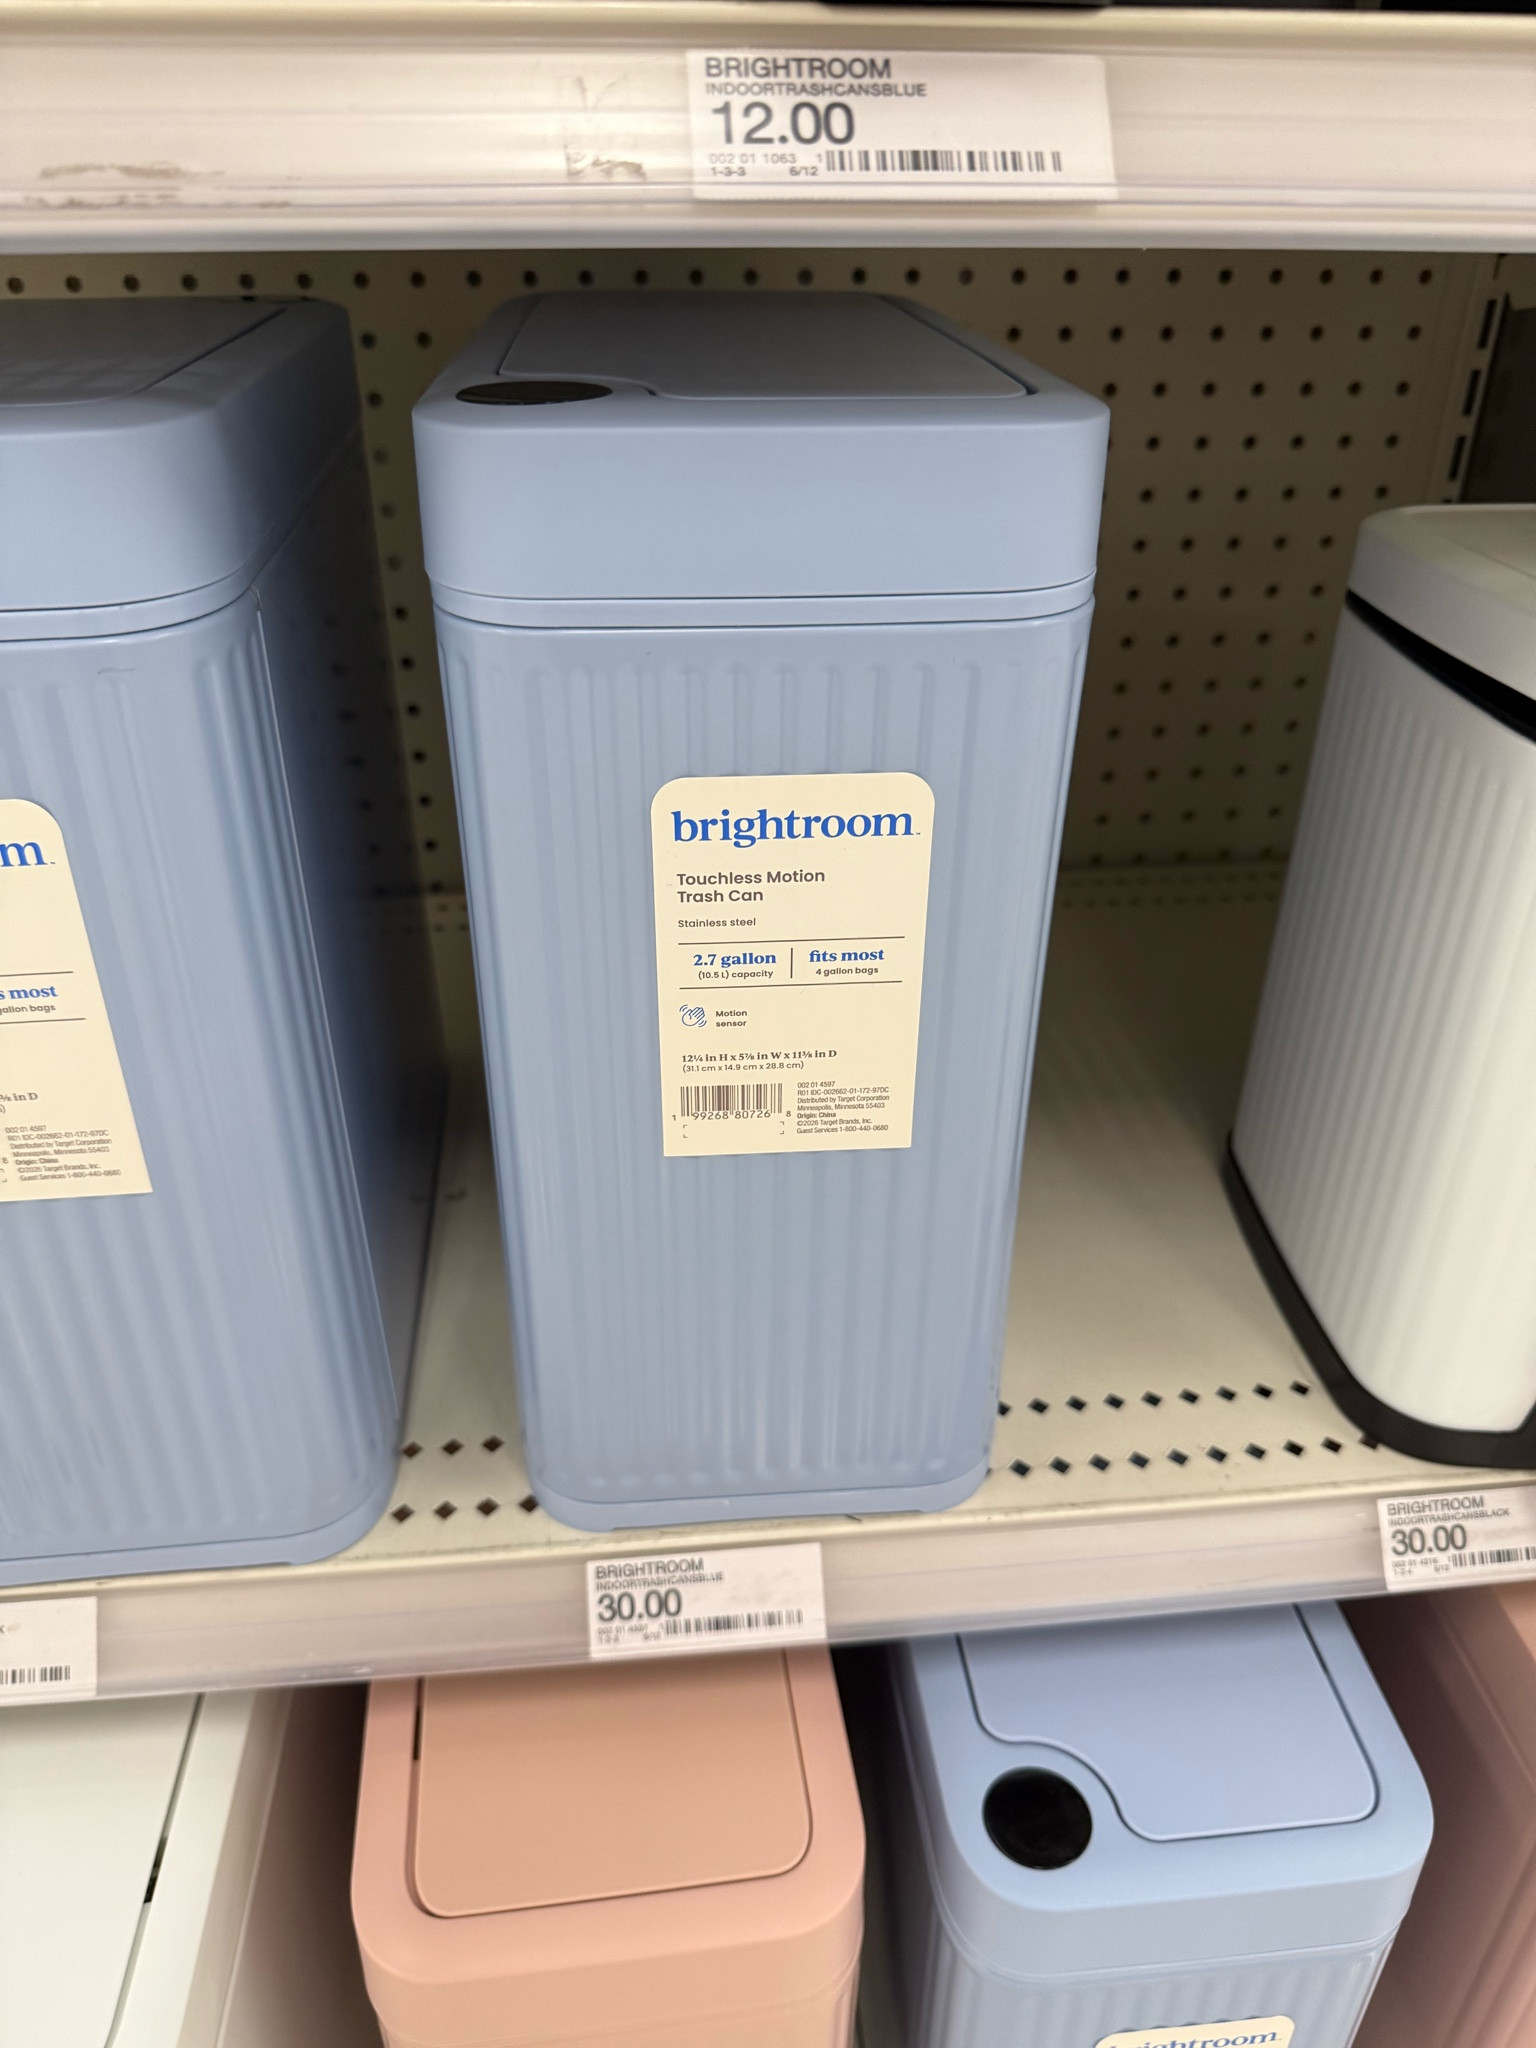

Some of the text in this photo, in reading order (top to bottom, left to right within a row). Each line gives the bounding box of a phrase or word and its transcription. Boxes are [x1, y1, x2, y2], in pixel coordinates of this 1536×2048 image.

[705, 57, 892, 79] BRIGHTROOM
[705, 83, 928, 97] INDOORTRASHCANSBLUE
[711, 101, 856, 146] 12.00
[709, 153, 735, 164] 002
[740, 153, 756, 164] 01
[763, 153, 797, 164] 1063
[711, 166, 746, 176] 1-3-3
[789, 166, 818, 176] 6/12
[677, 869, 826, 886] Touchless Motion
[677, 889, 764, 903] Trash Can
[678, 917, 757, 929] Stainless steel
[693, 952, 777, 969] 2.7 gallon
[808, 949, 885, 963] fits most
[698, 969, 774, 981] (10.5 L) capacity
[815, 966, 879, 977] 4 gallon bags
[8, 985, 58, 999] most
[29, 1005, 56, 1013] bags
[715, 1009, 748, 1018] Motion
[715, 1020, 747, 1028] sensor
[705, 1053, 716, 1062] in
[719, 1053, 728, 1061] H
[757, 1052, 768, 1060] in
[771, 1051, 782, 1060] W
[815, 1050, 826, 1059] in
[828, 1050, 837, 1058] D
[682, 1064, 700, 1073] (31.1
[786, 1060, 804, 1070] cm)
[13, 1093, 26, 1101] in
[28, 1092, 38, 1100] D
[837, 1095, 855, 1103] Target
[692, 1112, 729, 1120] 99268
[734, 1110, 771, 1119] 80726
[820, 1118, 838, 1126] Target
[1387, 1495, 1485, 1516] BRIGHTROOM
[1391, 1523, 1467, 1556] 30.00
[596, 1558, 704, 1579] BRIGHTROOM
[597, 1588, 682, 1622] 30.00
